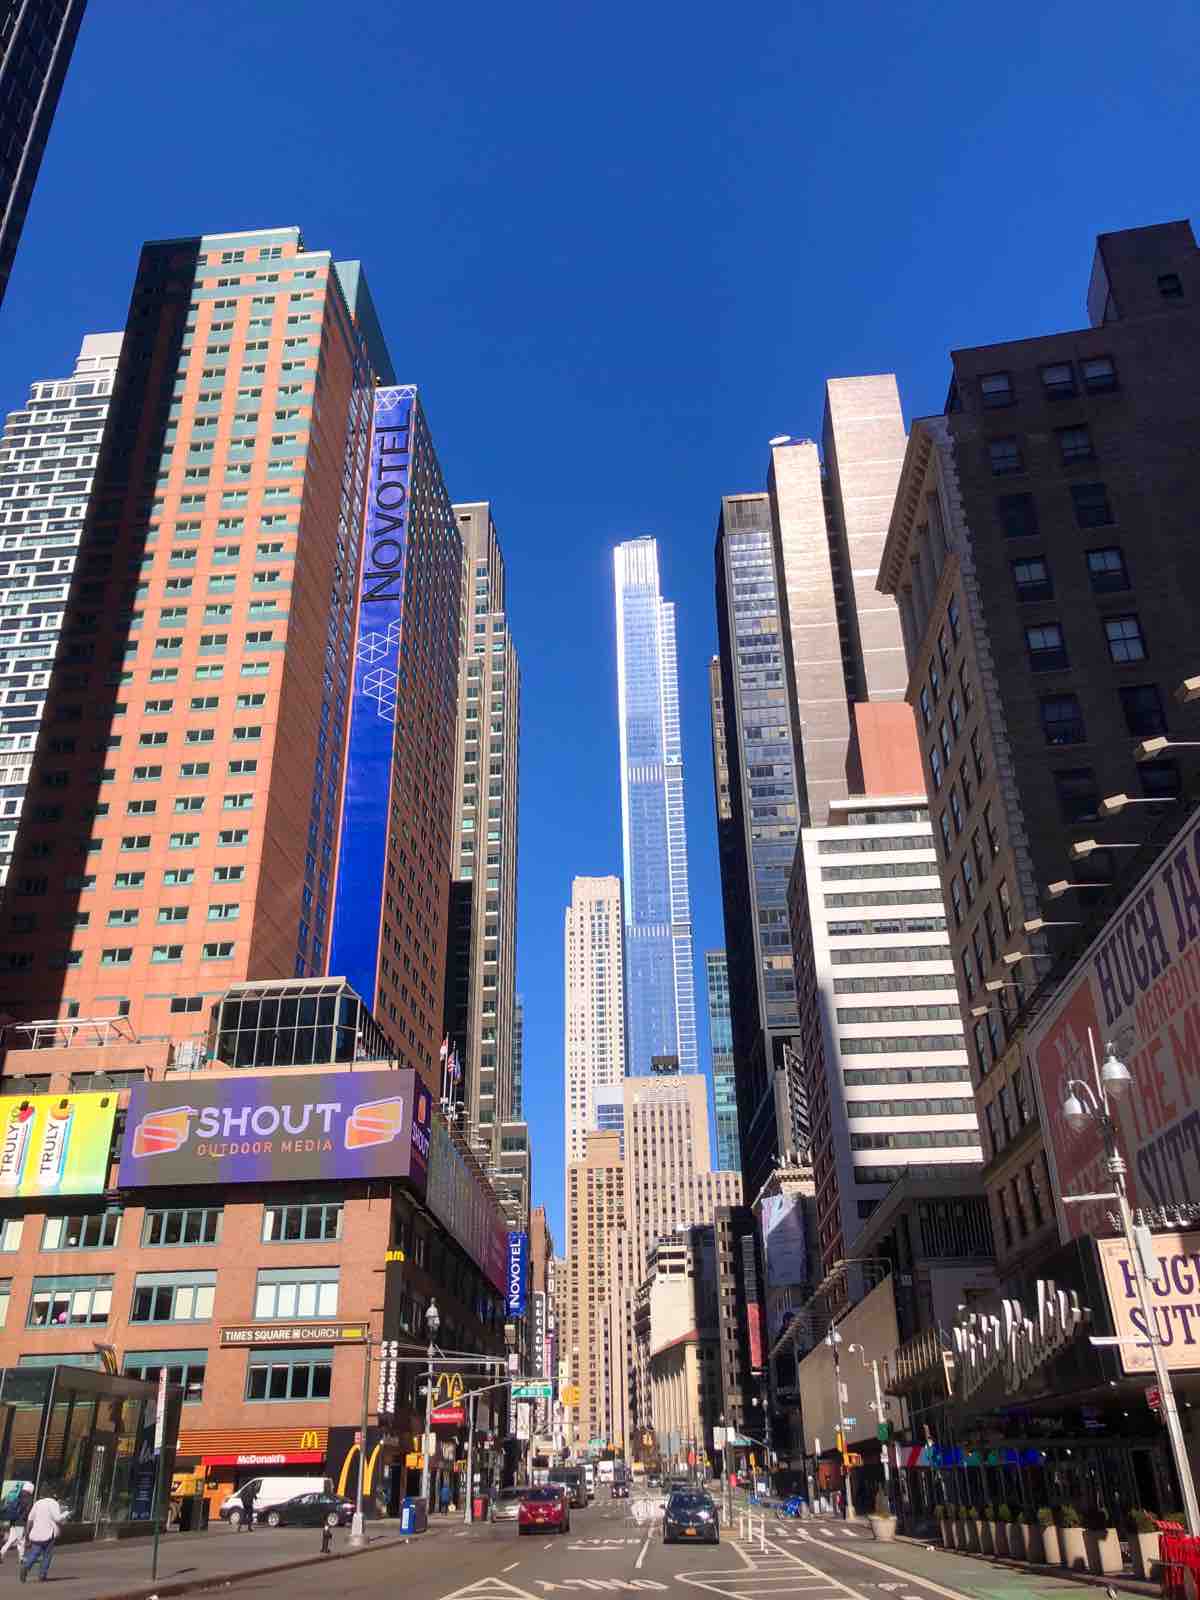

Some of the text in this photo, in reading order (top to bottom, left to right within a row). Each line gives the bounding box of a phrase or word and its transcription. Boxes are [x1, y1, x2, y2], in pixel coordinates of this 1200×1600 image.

[361, 409, 411, 603] NOVOTEL
[1093, 885, 1171, 1028] HUGH
[196, 1102, 342, 1137] SHOUT
[0, 1124, 19, 1176] TRULY
[40, 1123, 59, 1174] TRULY
[196, 1139, 333, 1157] OUTDOOR MEDIA
[509, 1238, 521, 1309] NOVOTEL
[225, 1328, 339, 1341] TIMES SQUARE CHURCH
[237, 1455, 286, 1464] McDonald's
